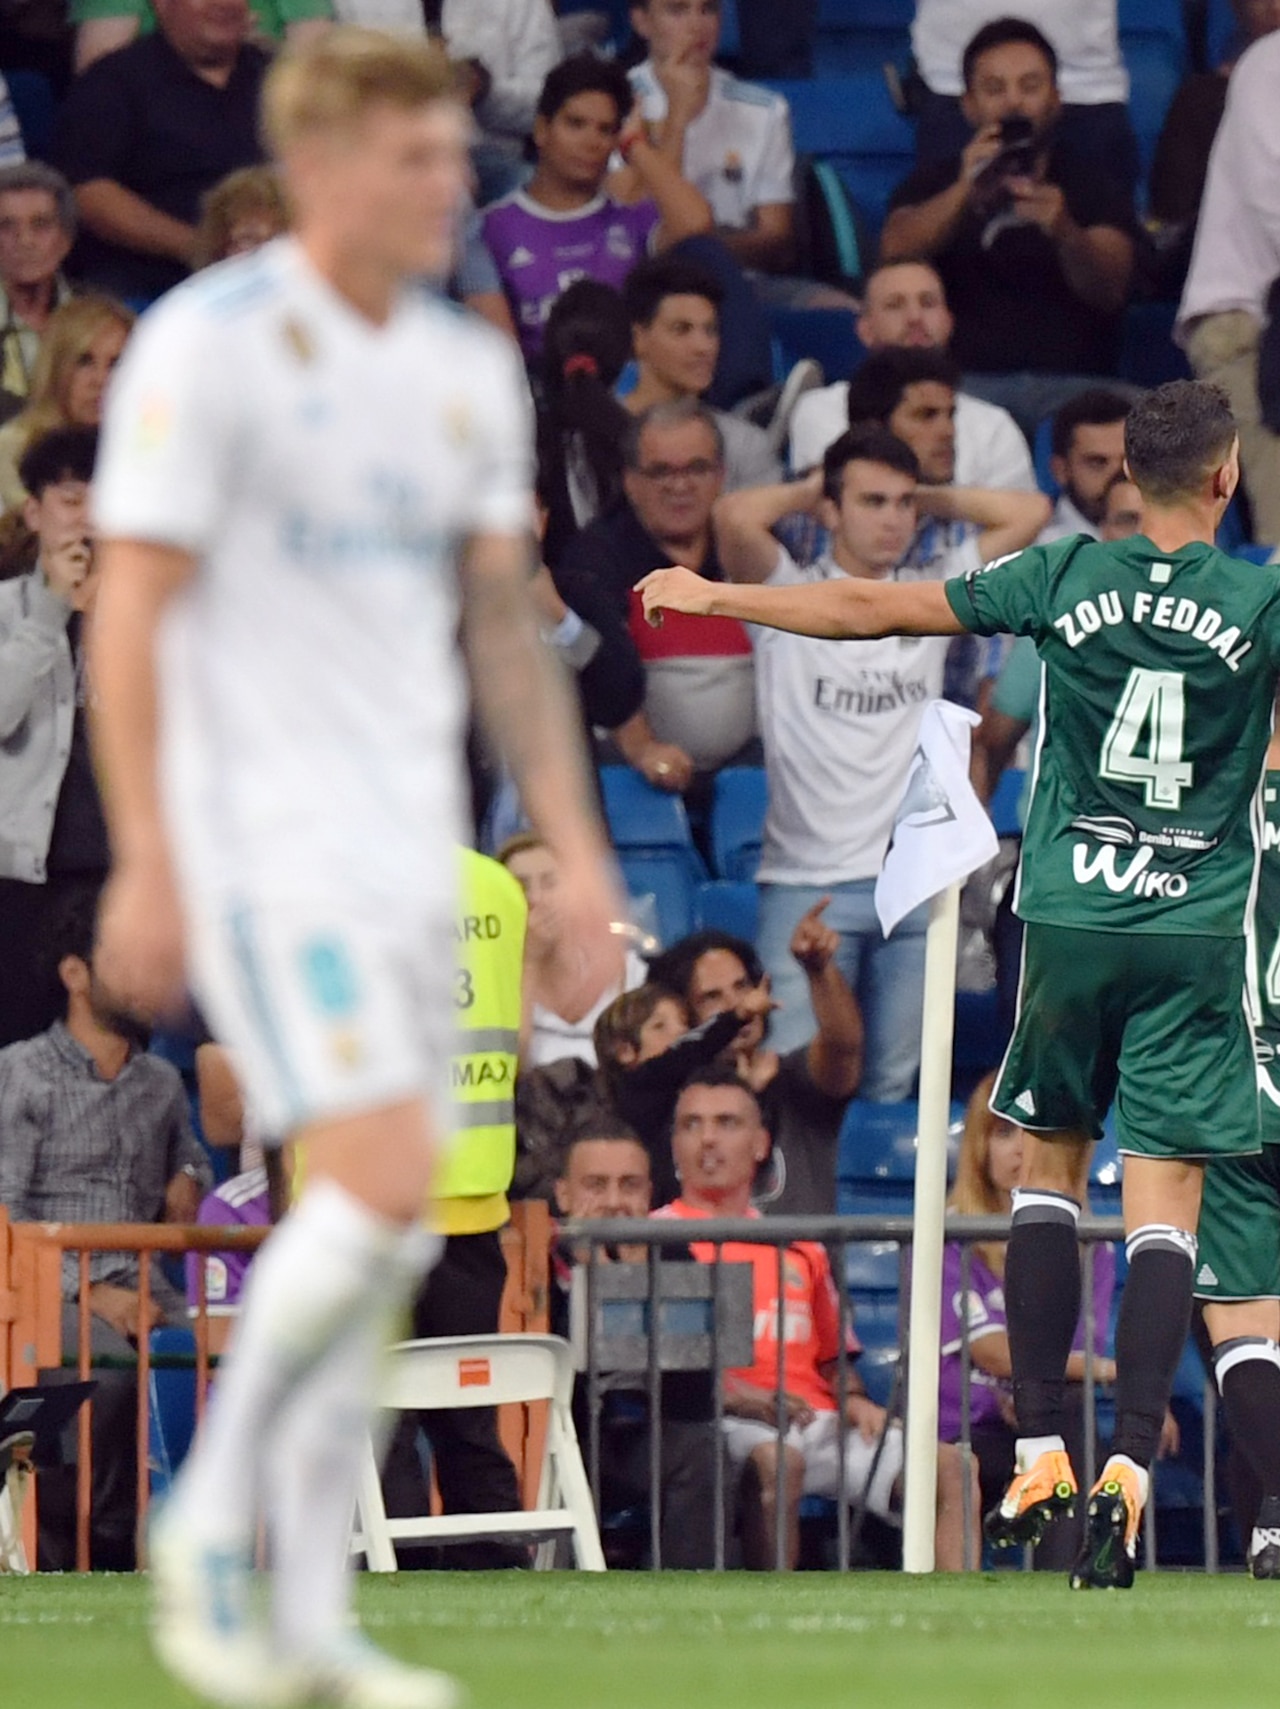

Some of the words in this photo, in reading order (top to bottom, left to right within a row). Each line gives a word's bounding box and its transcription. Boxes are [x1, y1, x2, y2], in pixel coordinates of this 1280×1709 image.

[1053, 590, 1124, 648] ZOU
[1132, 591, 1252, 672] FEDDAL
[1099, 666, 1194, 812] 4
